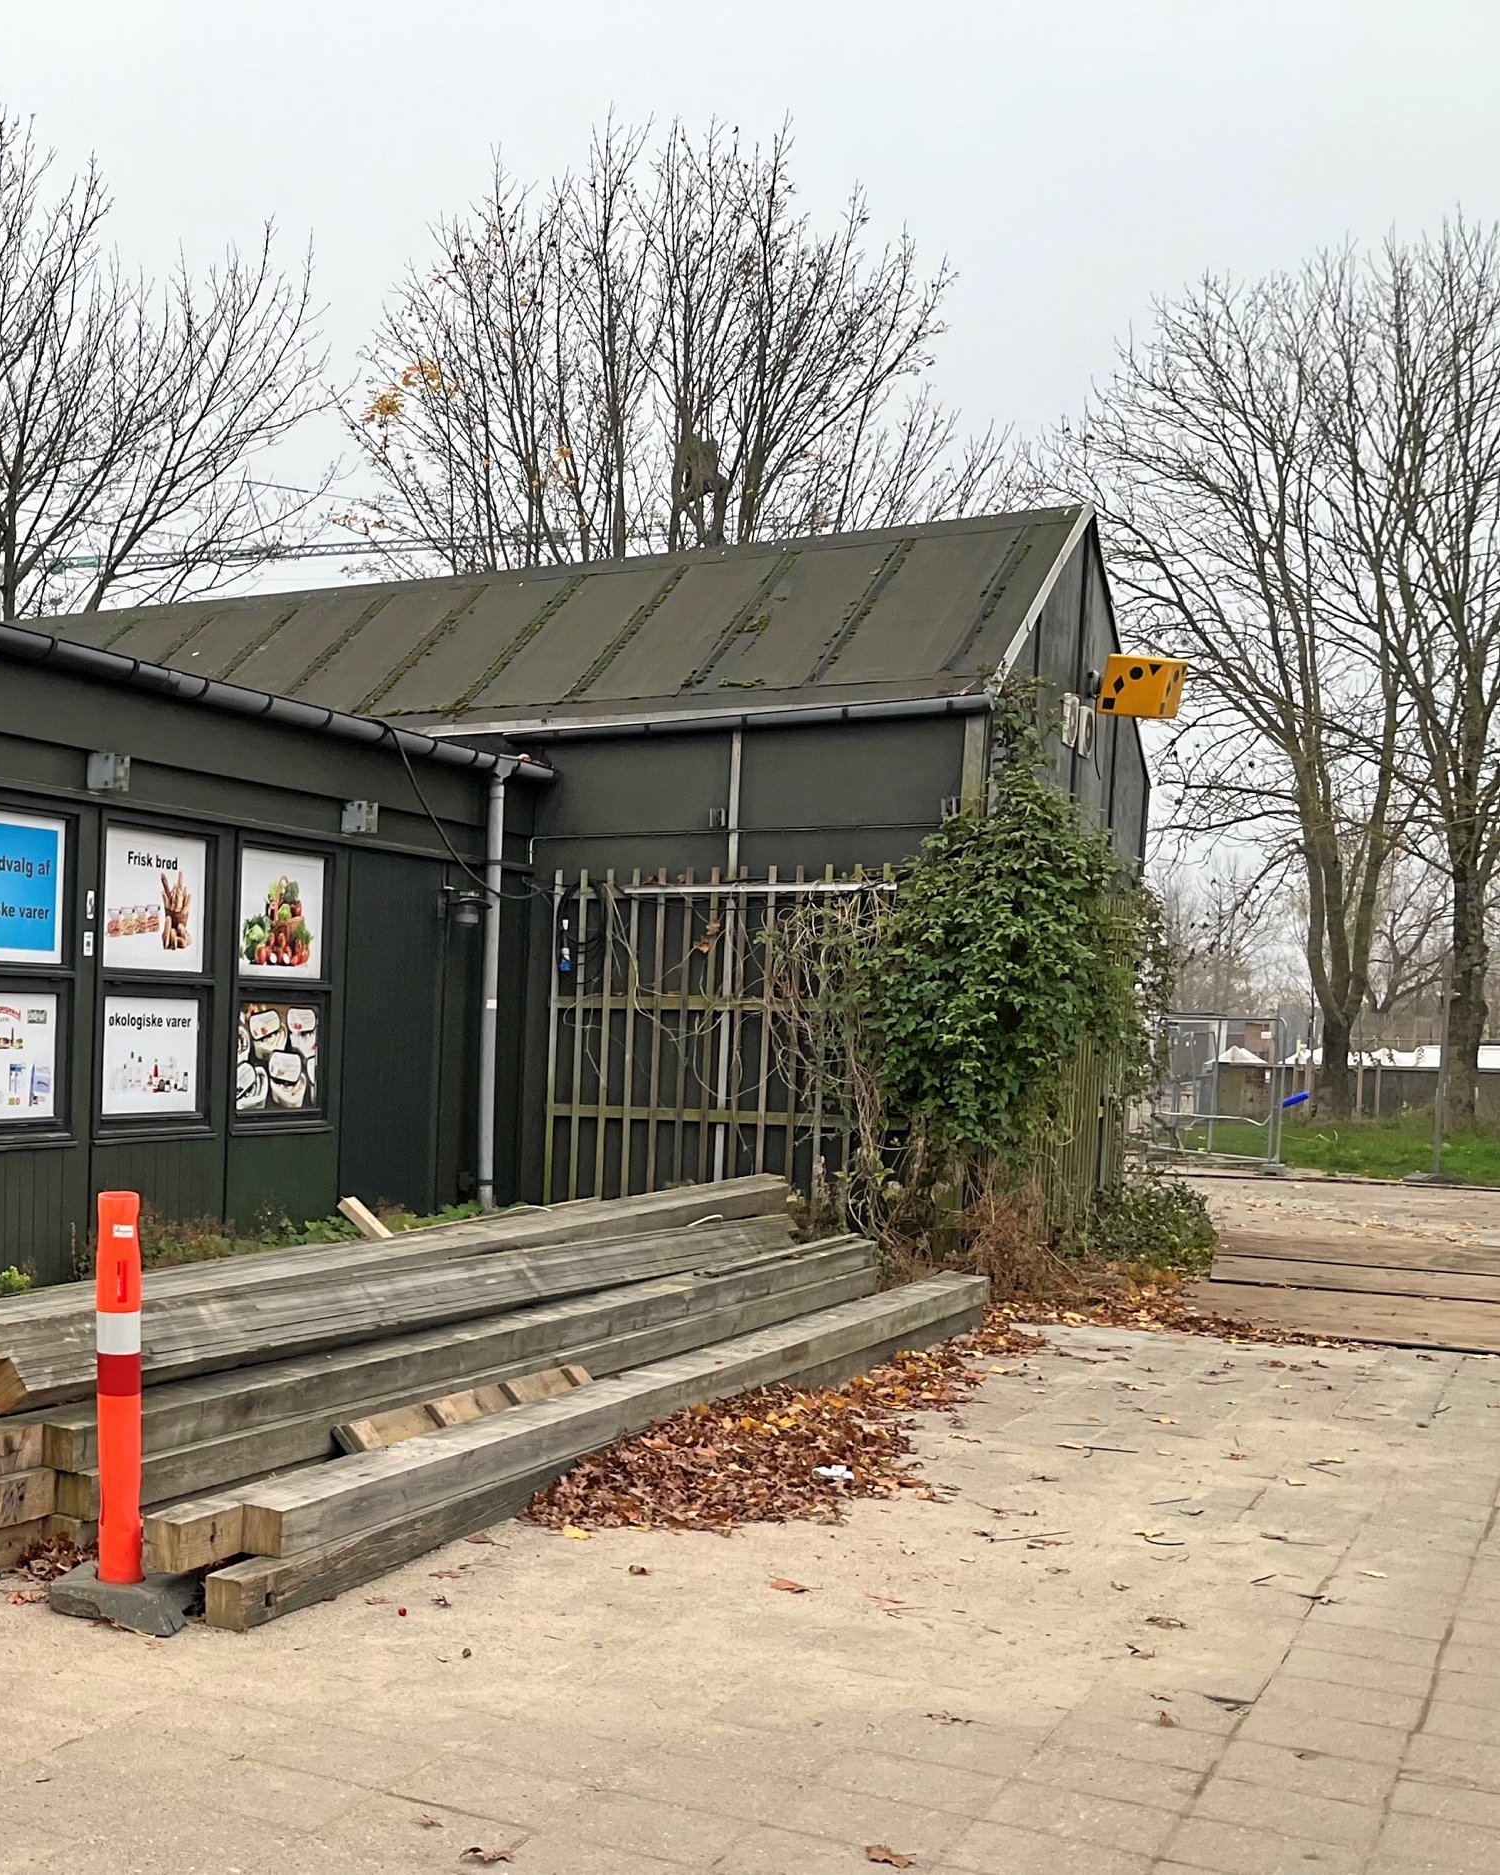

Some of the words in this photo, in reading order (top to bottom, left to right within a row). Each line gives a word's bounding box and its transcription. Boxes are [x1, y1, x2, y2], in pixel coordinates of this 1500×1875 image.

[38, 860, 51, 875] af
[128, 851, 153, 867] Frisk
[156, 855, 178, 870] brød
[19, 907, 49, 919] varer
[108, 1013, 163, 1030] økologiske
[166, 1017, 192, 1028] varer
